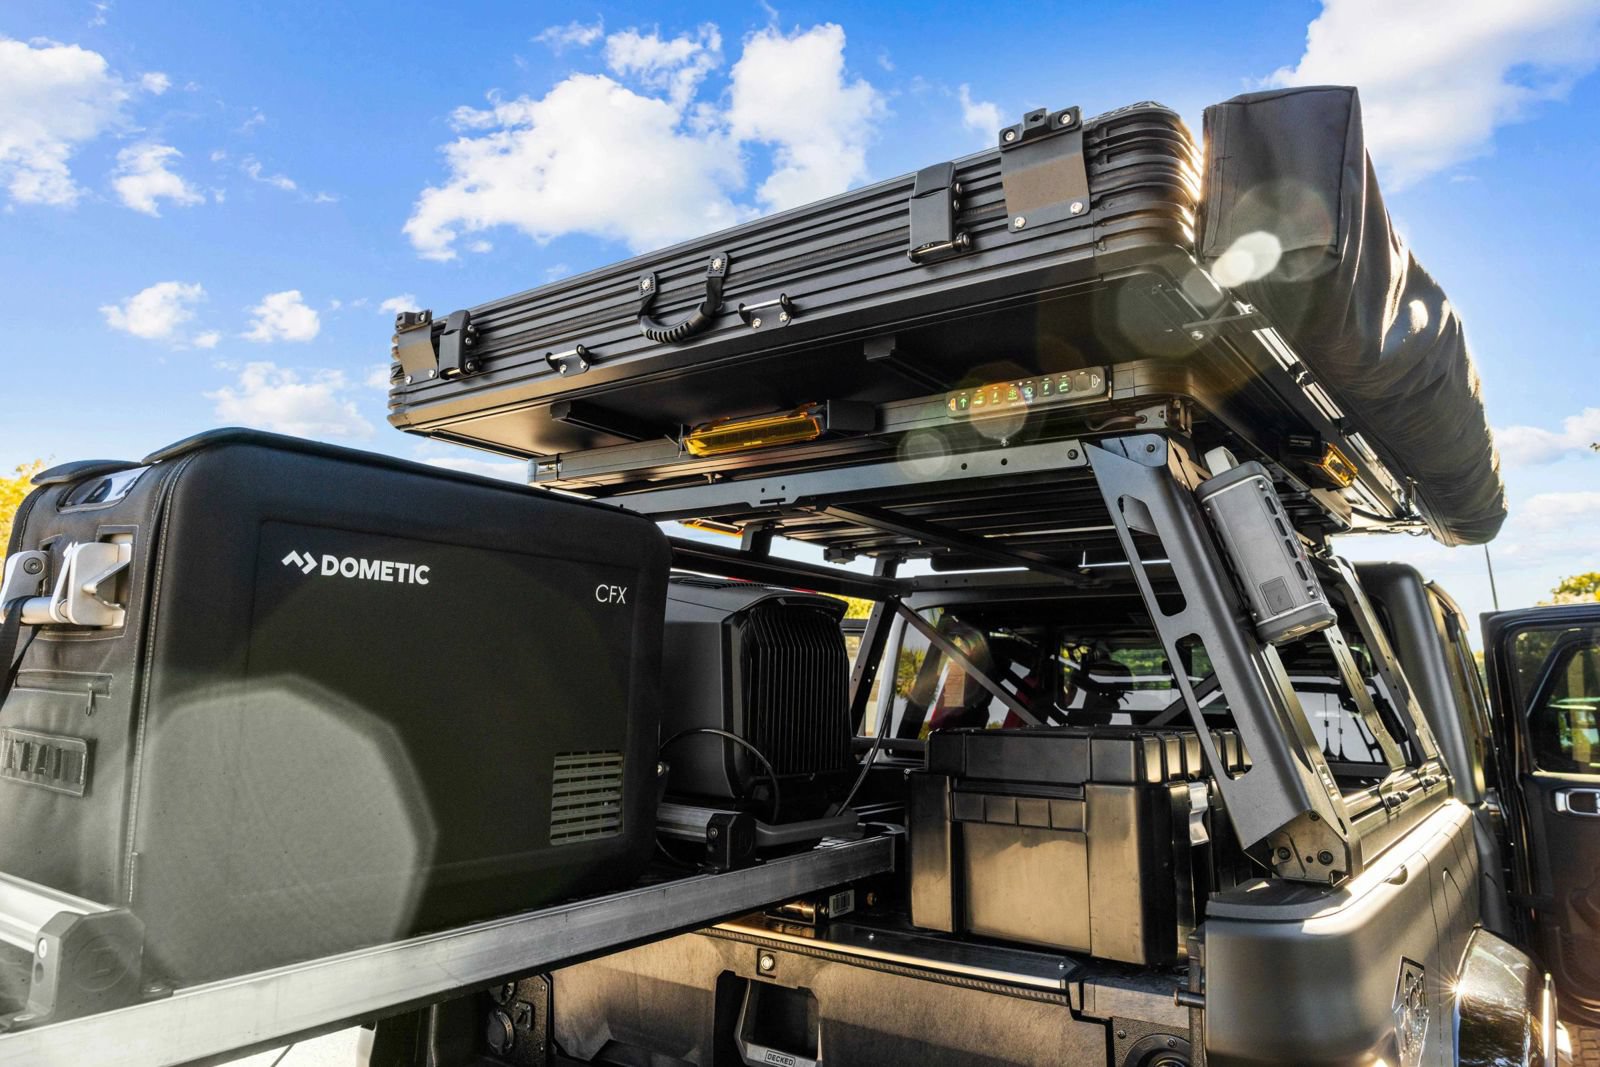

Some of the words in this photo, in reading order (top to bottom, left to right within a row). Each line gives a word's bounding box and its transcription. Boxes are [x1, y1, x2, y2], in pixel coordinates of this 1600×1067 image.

[321, 554, 431, 585] DOMETIC
[595, 584, 627, 604] CFX
[767, 1053, 794, 1066] DECKED
